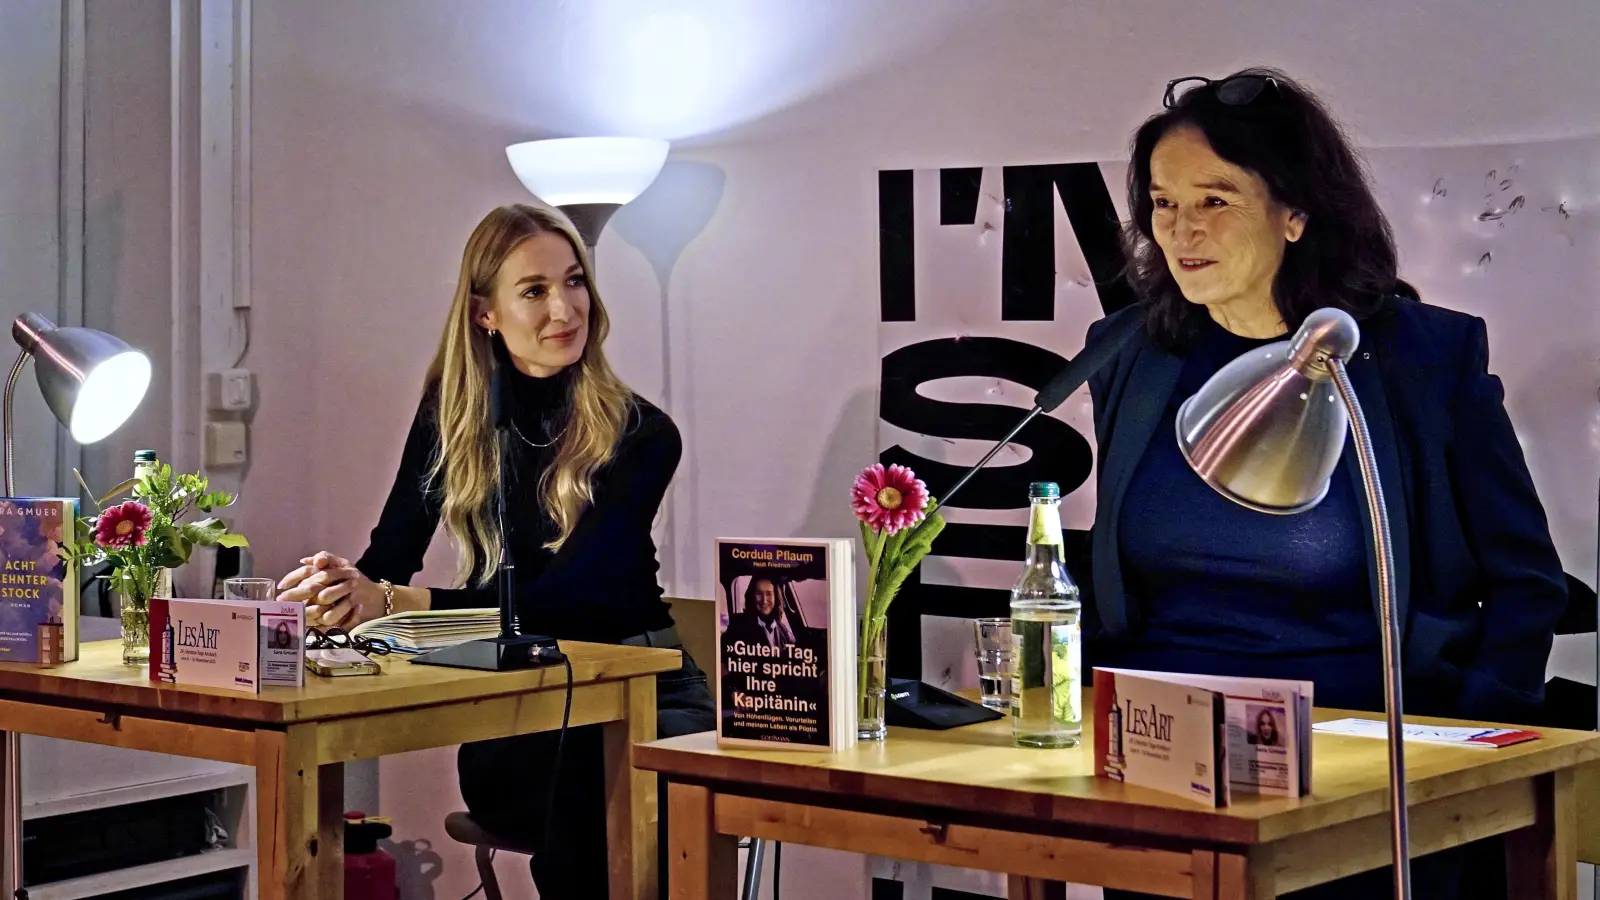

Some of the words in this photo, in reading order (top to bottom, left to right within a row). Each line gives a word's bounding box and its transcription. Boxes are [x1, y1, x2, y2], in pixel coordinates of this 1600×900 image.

[17, 508, 58, 517] GMUER
[731, 548, 773, 560] Cordula
[776, 550, 813, 562] Pflaum
[5, 560, 36, 571] ACHT
[0, 574, 48, 585] EHNTER
[2, 588, 40, 599] STOCK
[785, 644, 818, 664] Tag,
[728, 657, 758, 673] hier
[763, 661, 818, 678] spricht
[746, 676, 776, 692] Ihre
[785, 716, 817, 724] Vorurteilen
[799, 724, 817, 733] Pilotin
